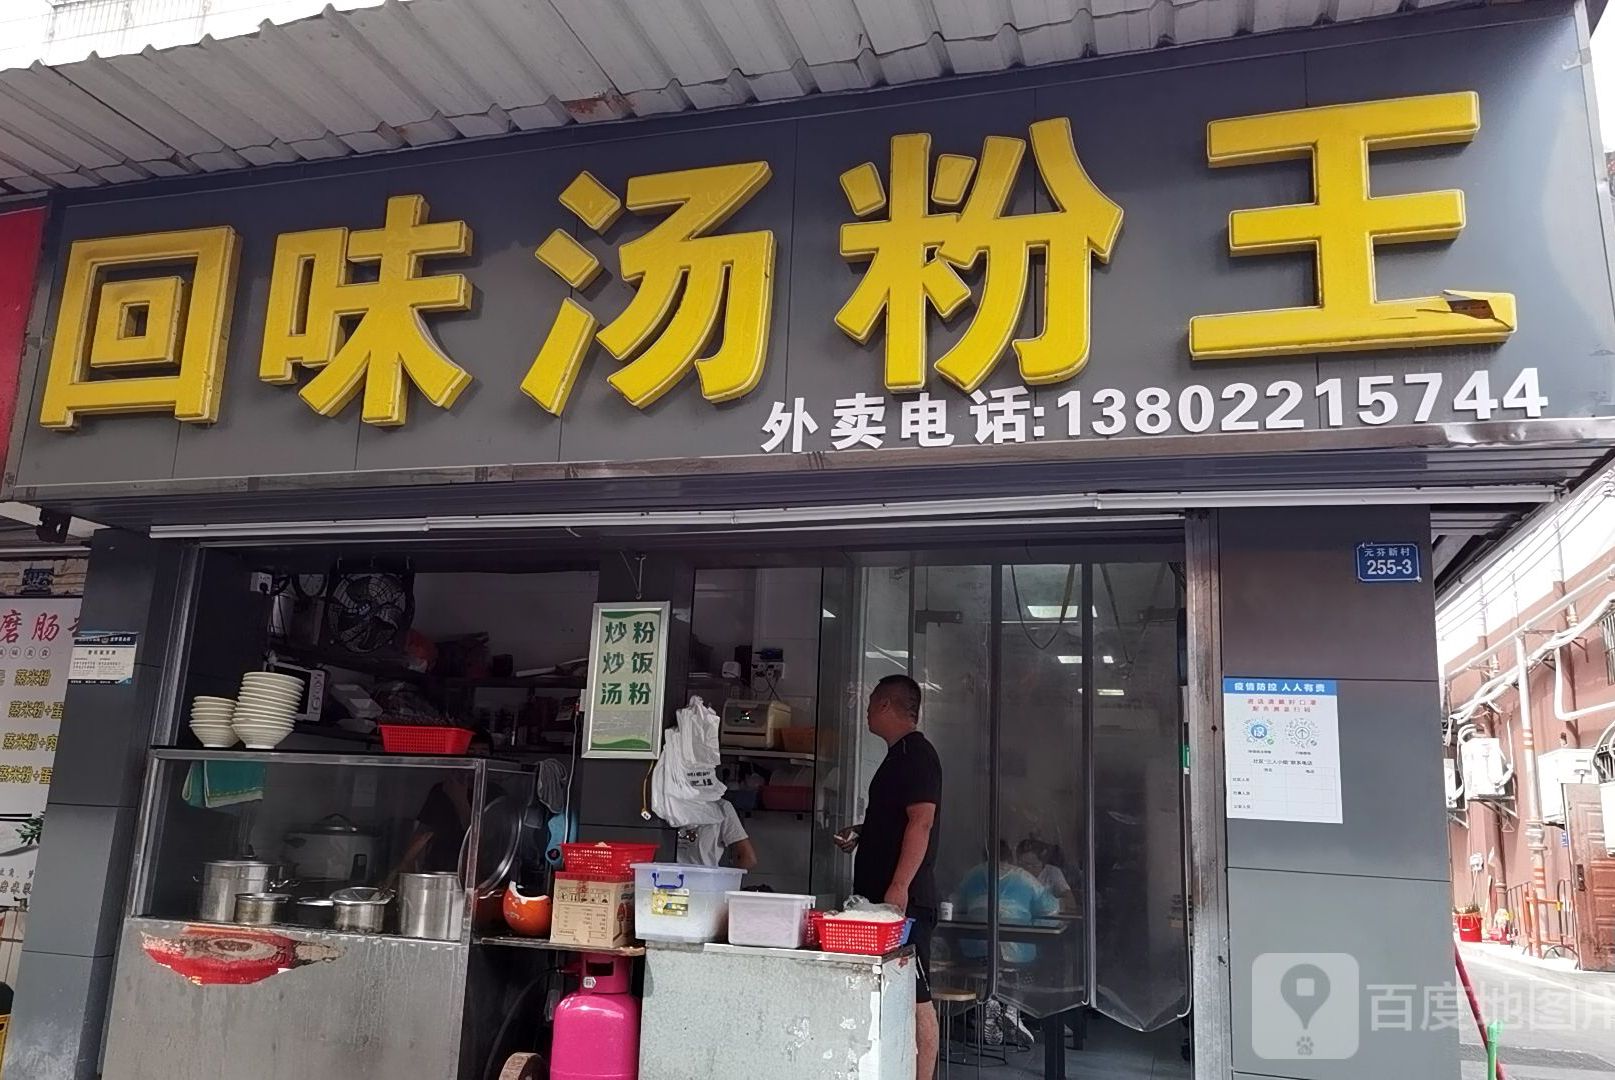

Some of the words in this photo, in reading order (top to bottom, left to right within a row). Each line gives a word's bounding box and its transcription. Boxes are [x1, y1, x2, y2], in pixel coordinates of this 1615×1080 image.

[40, 91, 1518, 431] 回味汤粉王
[1364, 547, 1410, 557] 元芬新村
[1367, 559, 1412, 575] 255-3
[604, 621, 655, 644] 炒粉
[602, 652, 654, 674] 炒饭
[600, 682, 651, 705] 汤粉
[1234, 682, 1277, 691] 疫情防控
[1281, 683, 1325, 692] 人人有责
